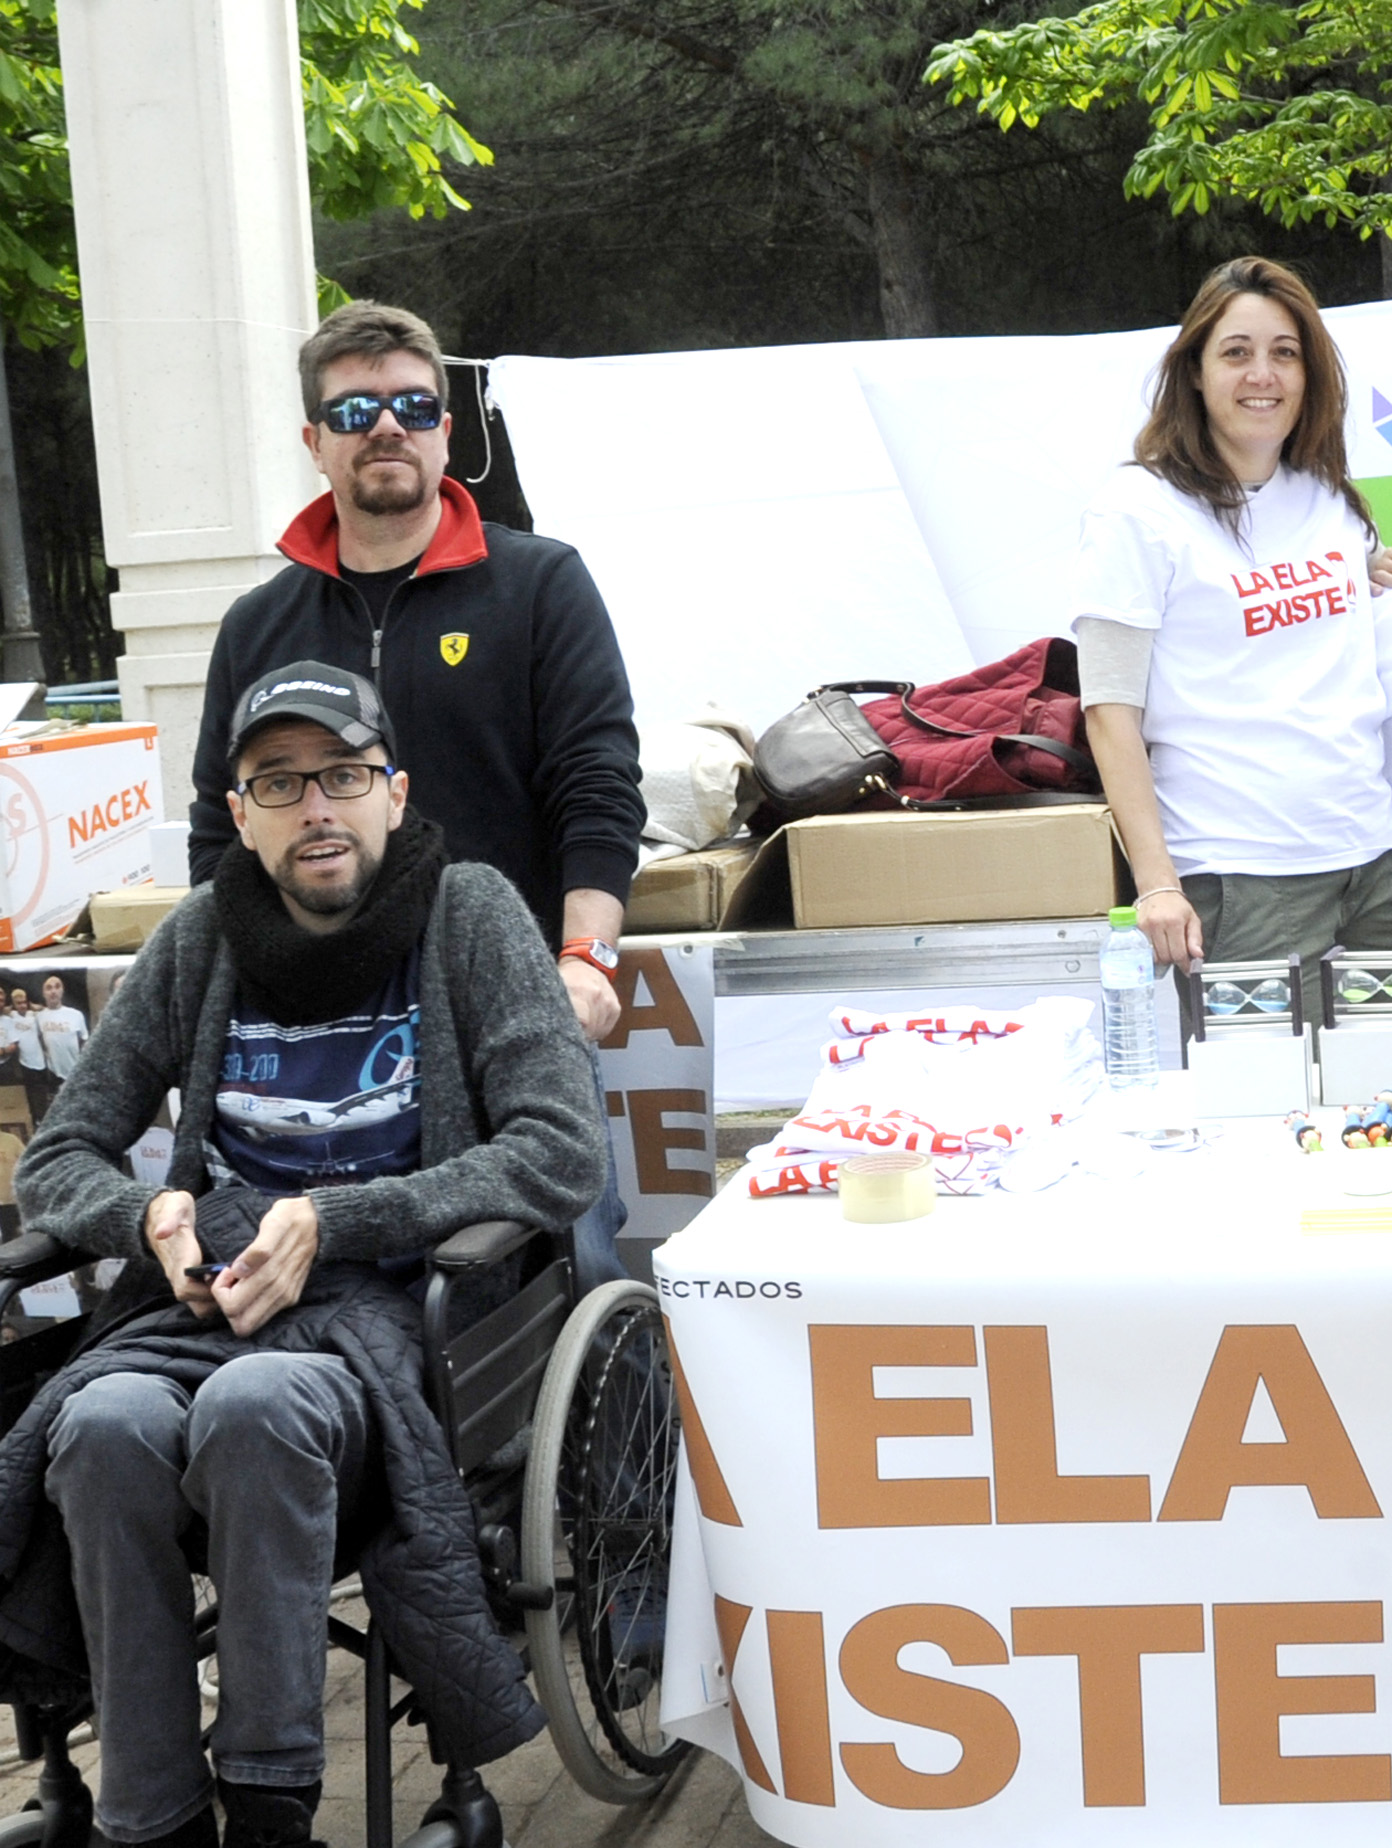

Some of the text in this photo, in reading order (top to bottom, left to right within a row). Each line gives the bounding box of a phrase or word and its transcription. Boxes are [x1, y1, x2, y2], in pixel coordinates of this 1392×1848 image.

[1230, 560, 1333, 598] LA ELA
[1243, 586, 1347, 637] EXISTE
[68, 780, 152, 849] NACEX
[654, 1275, 803, 1299] ECTADOS
[807, 1324, 1384, 1530] ELA
